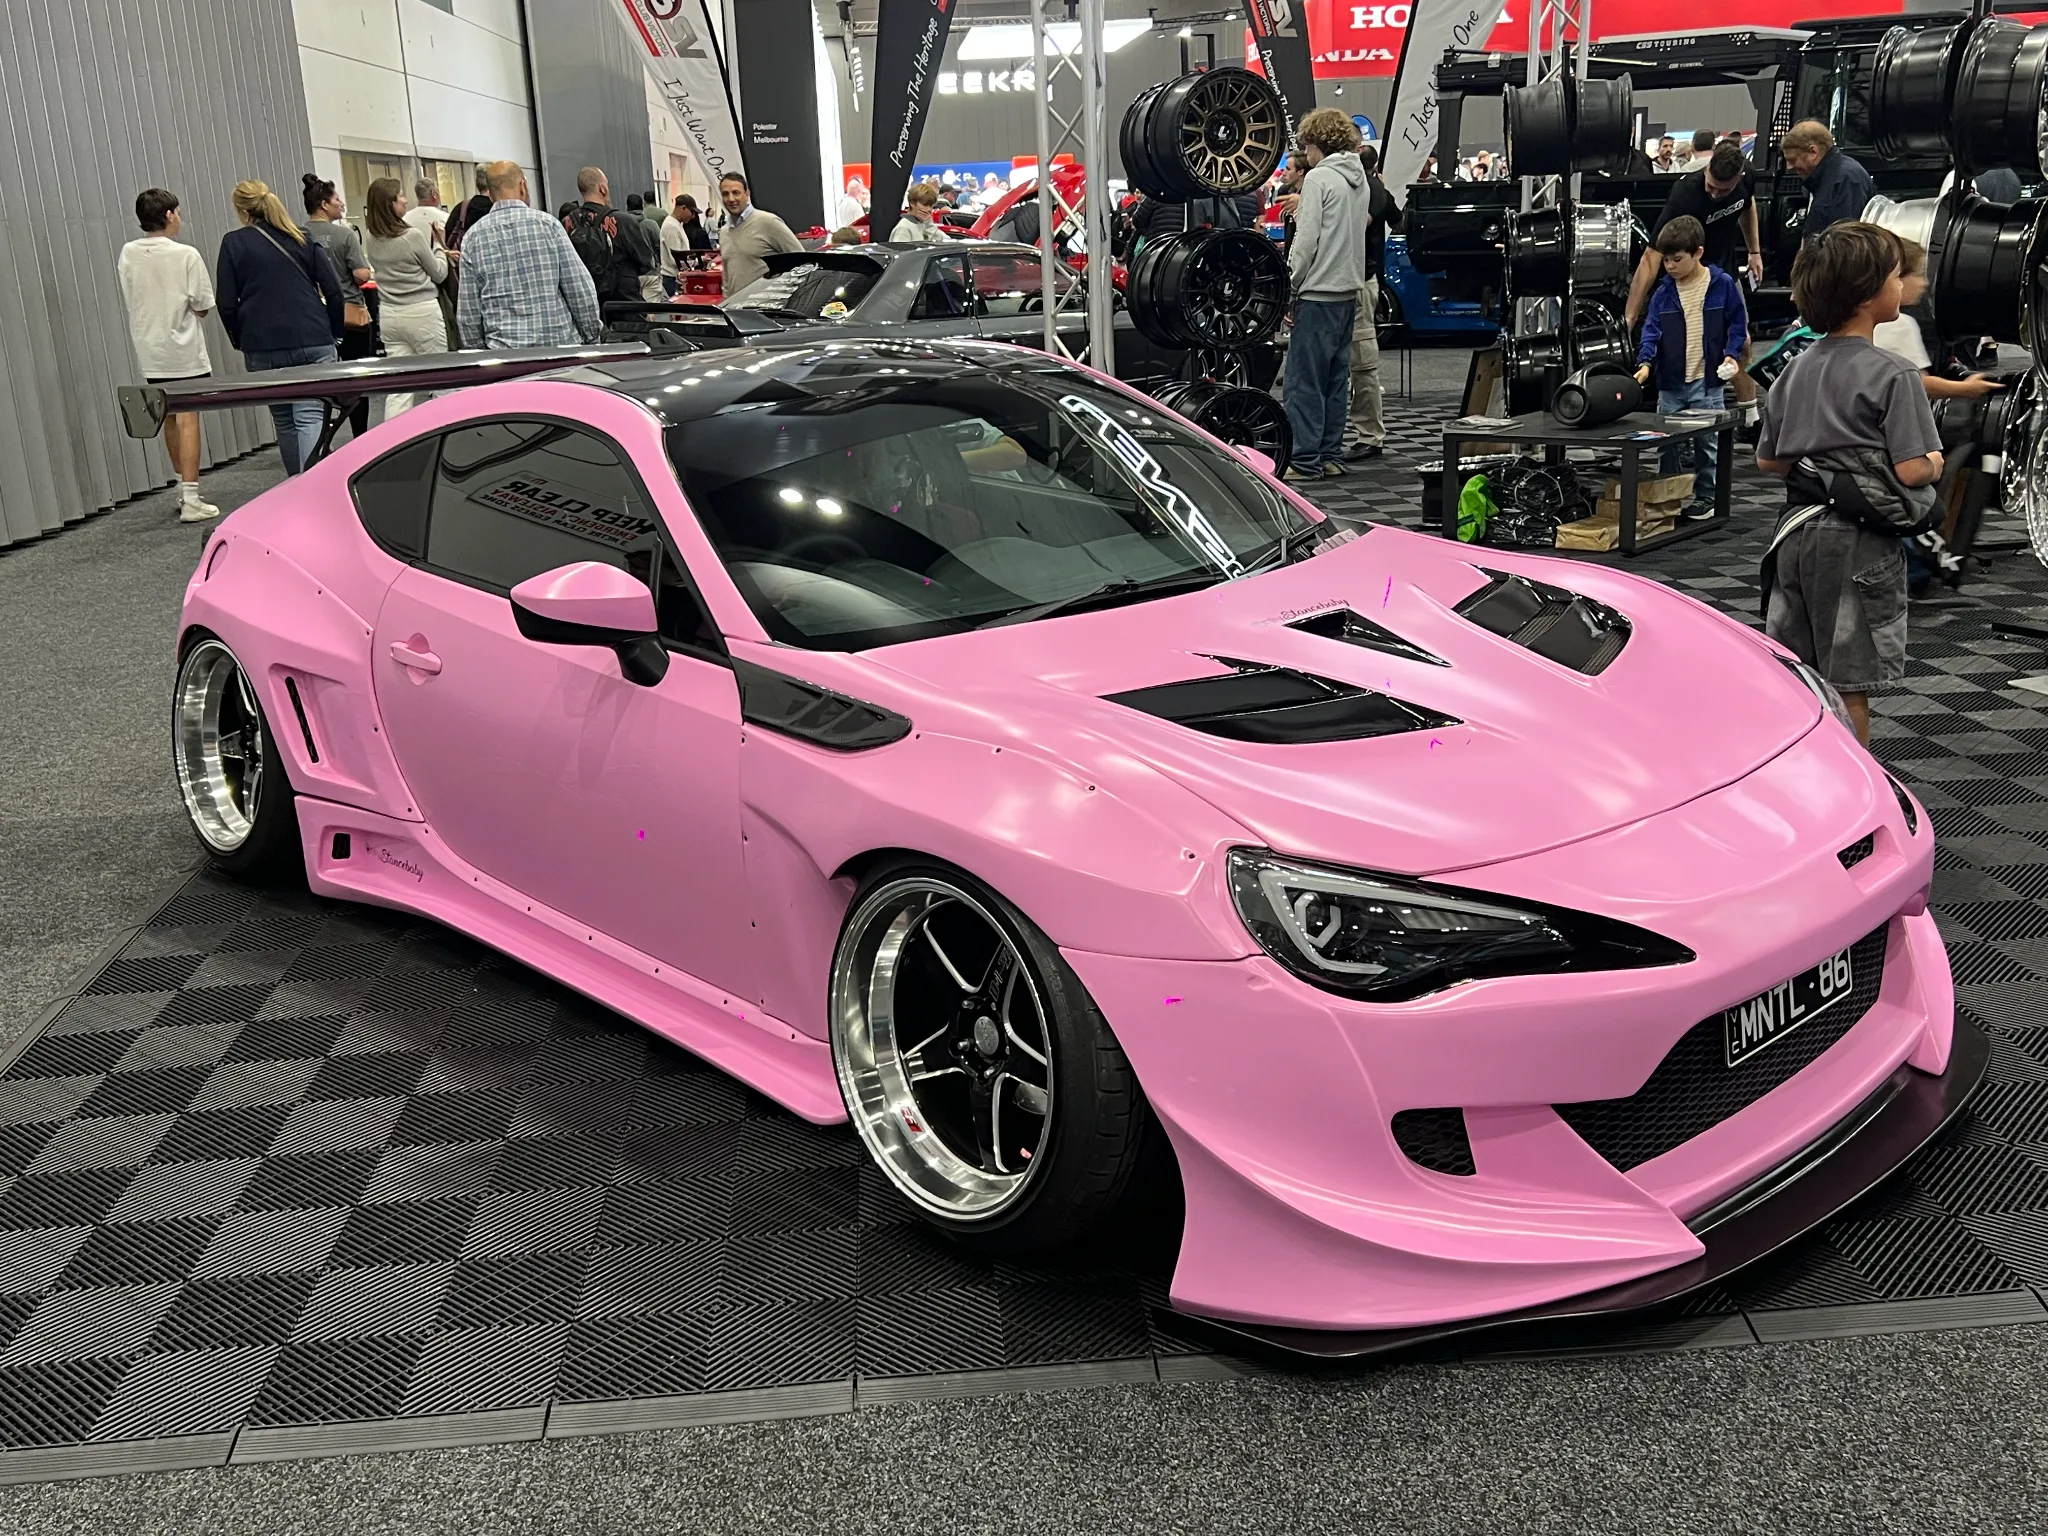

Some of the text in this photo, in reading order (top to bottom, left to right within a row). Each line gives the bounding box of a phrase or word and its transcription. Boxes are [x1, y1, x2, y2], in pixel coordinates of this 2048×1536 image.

[1258, 2, 1272, 37] VICTORIA
[1453, 10, 1479, 46] One
[647, 20, 669, 57] VICTORIA
[1654, 38, 1696, 48] TOURING
[663, 77, 683, 90] I
[889, 17, 938, 168] Preserving The Heritage
[937, 70, 1036, 94] EEKR
[667, 92, 694, 117] Just
[1410, 96, 1438, 138] Just
[686, 118, 715, 155] Want
[753, 123, 778, 131] Polestar
[1403, 127, 1420, 151] I
[1730, 1009, 1740, 1054] VIC
